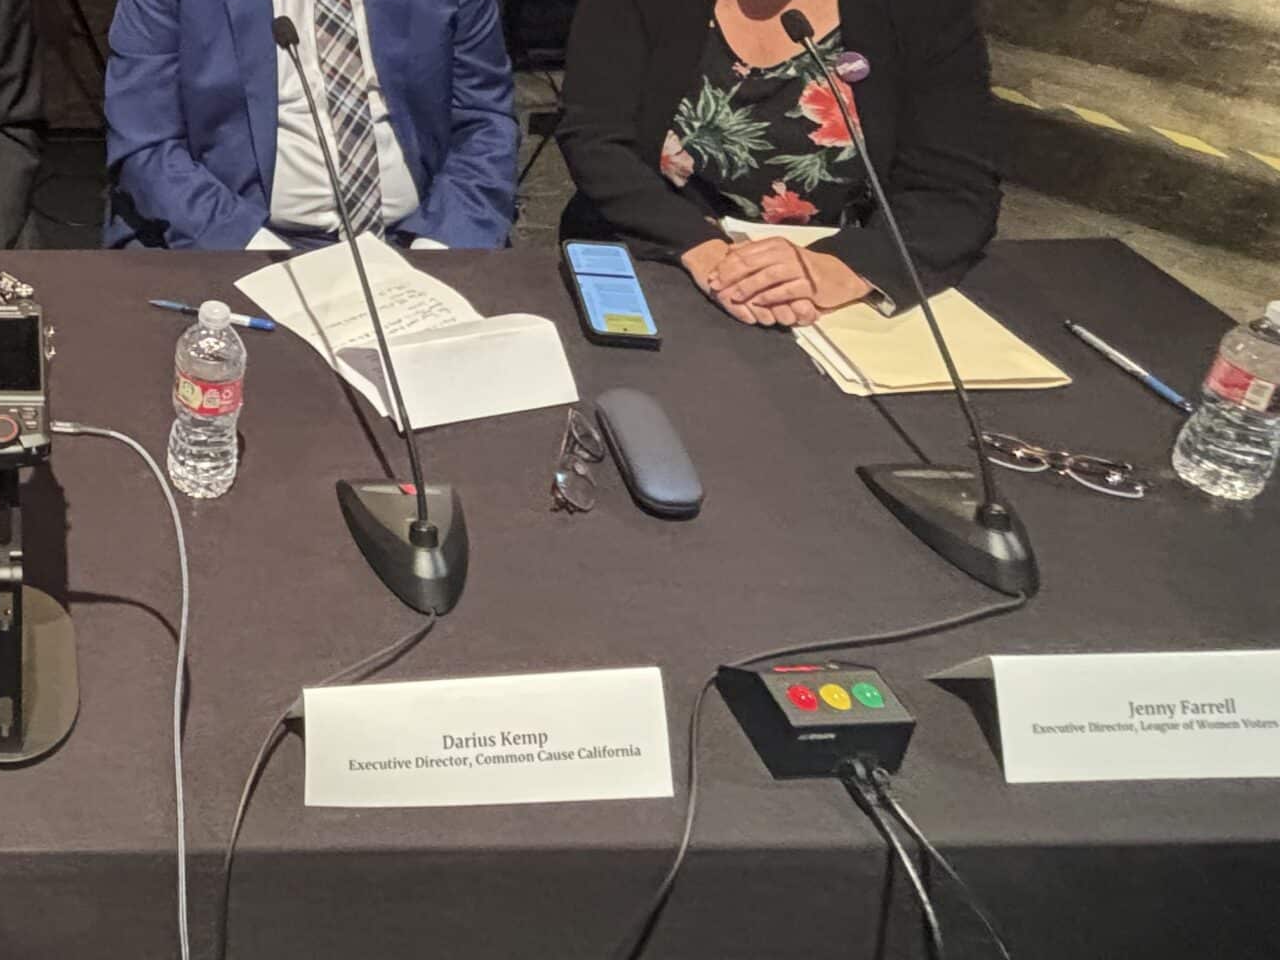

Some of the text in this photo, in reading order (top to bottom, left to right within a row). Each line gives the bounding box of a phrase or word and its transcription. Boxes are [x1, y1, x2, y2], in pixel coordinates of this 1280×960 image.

[1128, 698, 1236, 719] Jenny Farrell
[1032, 723, 1086, 735] Executive
[1088, 721, 1138, 734] Director,
[1140, 720, 1180, 733] League
[1182, 719, 1195, 731] of
[1196, 719, 1240, 730] Women
[442, 730, 548, 750] Darius Kemp
[349, 744, 642, 771] Executive Director, Common Cause California
